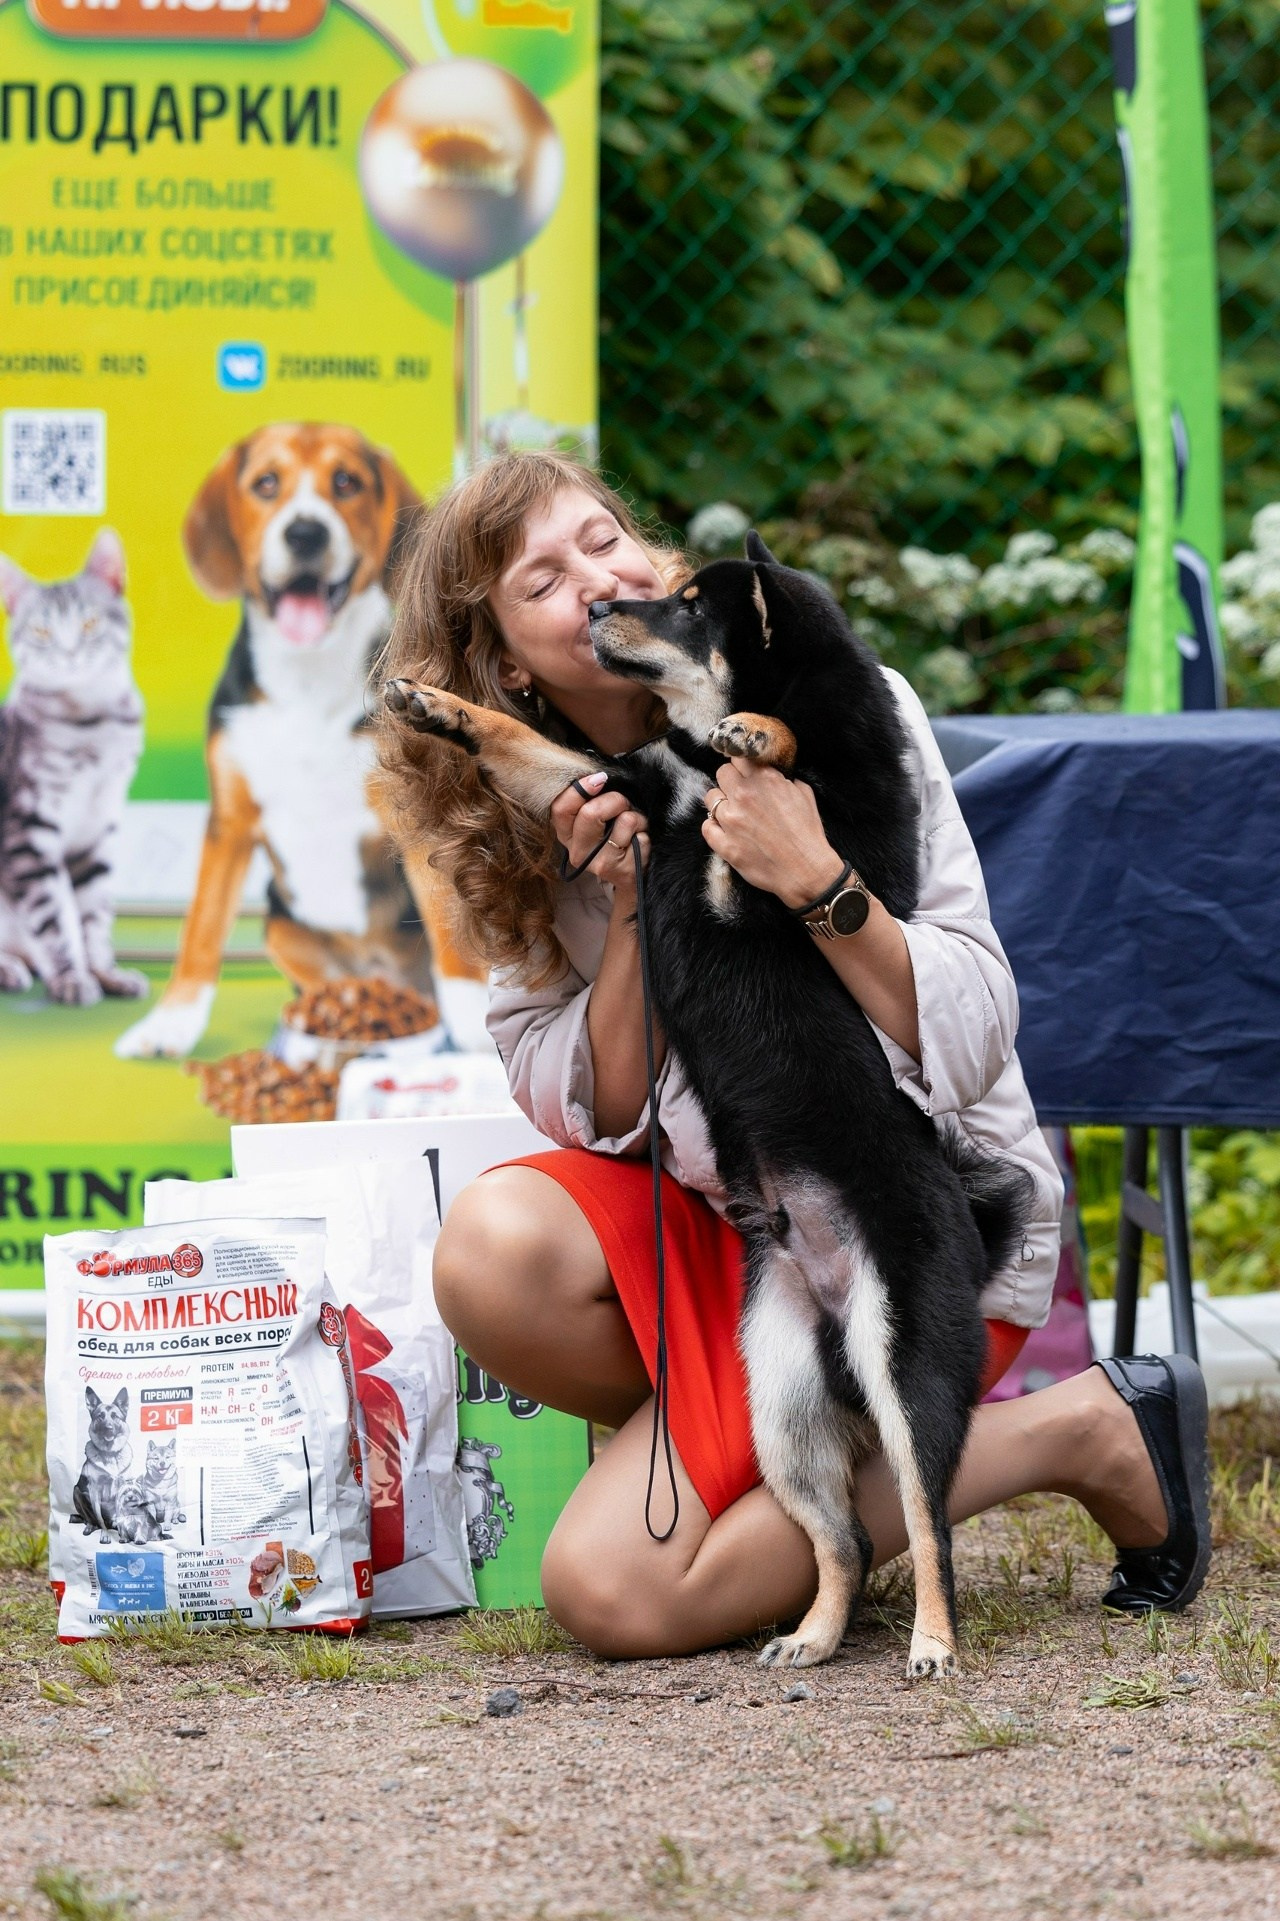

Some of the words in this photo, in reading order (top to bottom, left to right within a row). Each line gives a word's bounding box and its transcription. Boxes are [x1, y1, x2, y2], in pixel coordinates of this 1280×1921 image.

[0, 82, 340, 154] ПОДАРКИ!
[136, 177, 275, 212] БОЛЬШЕ
[27, 227, 146, 258] НАШИХ
[160, 226, 334, 263] СОЦСЕТЯХ
[0, 1168, 188, 1219] RIN
[172, 1249, 202, 1272] 365
[148, 1275, 173, 1288] ЕДЫ
[77, 1279, 298, 1332] КОМПЛЕКСНЫЙ
[78, 1339, 118, 1354] обед
[123, 1341, 155, 1354] для
[160, 1335, 210, 1350] собак
[215, 1332, 252, 1346] всех
[78, 1366, 123, 1383] Сделано
[135, 1364, 191, 1380] любовью!
[201, 1363, 234, 1373] PROTEIN
[144, 1389, 190, 1401] ПРЕМИУМ
[228, 1387, 234, 1396] R
[148, 1410, 160, 1427] 2
[166, 1408, 185, 1425] КГ
[176, 1551, 203, 1559] ПРОТЕИН
[202, 1558, 224, 1567] МАСЛА
[177, 1570, 209, 1579] УГЛЕВОДЫ
[361, 1568, 370, 1591] 2
[178, 1580, 213, 1590] КЛЕТЧАТКА
[179, 1591, 211, 1599] ВИТАМИНЫ
